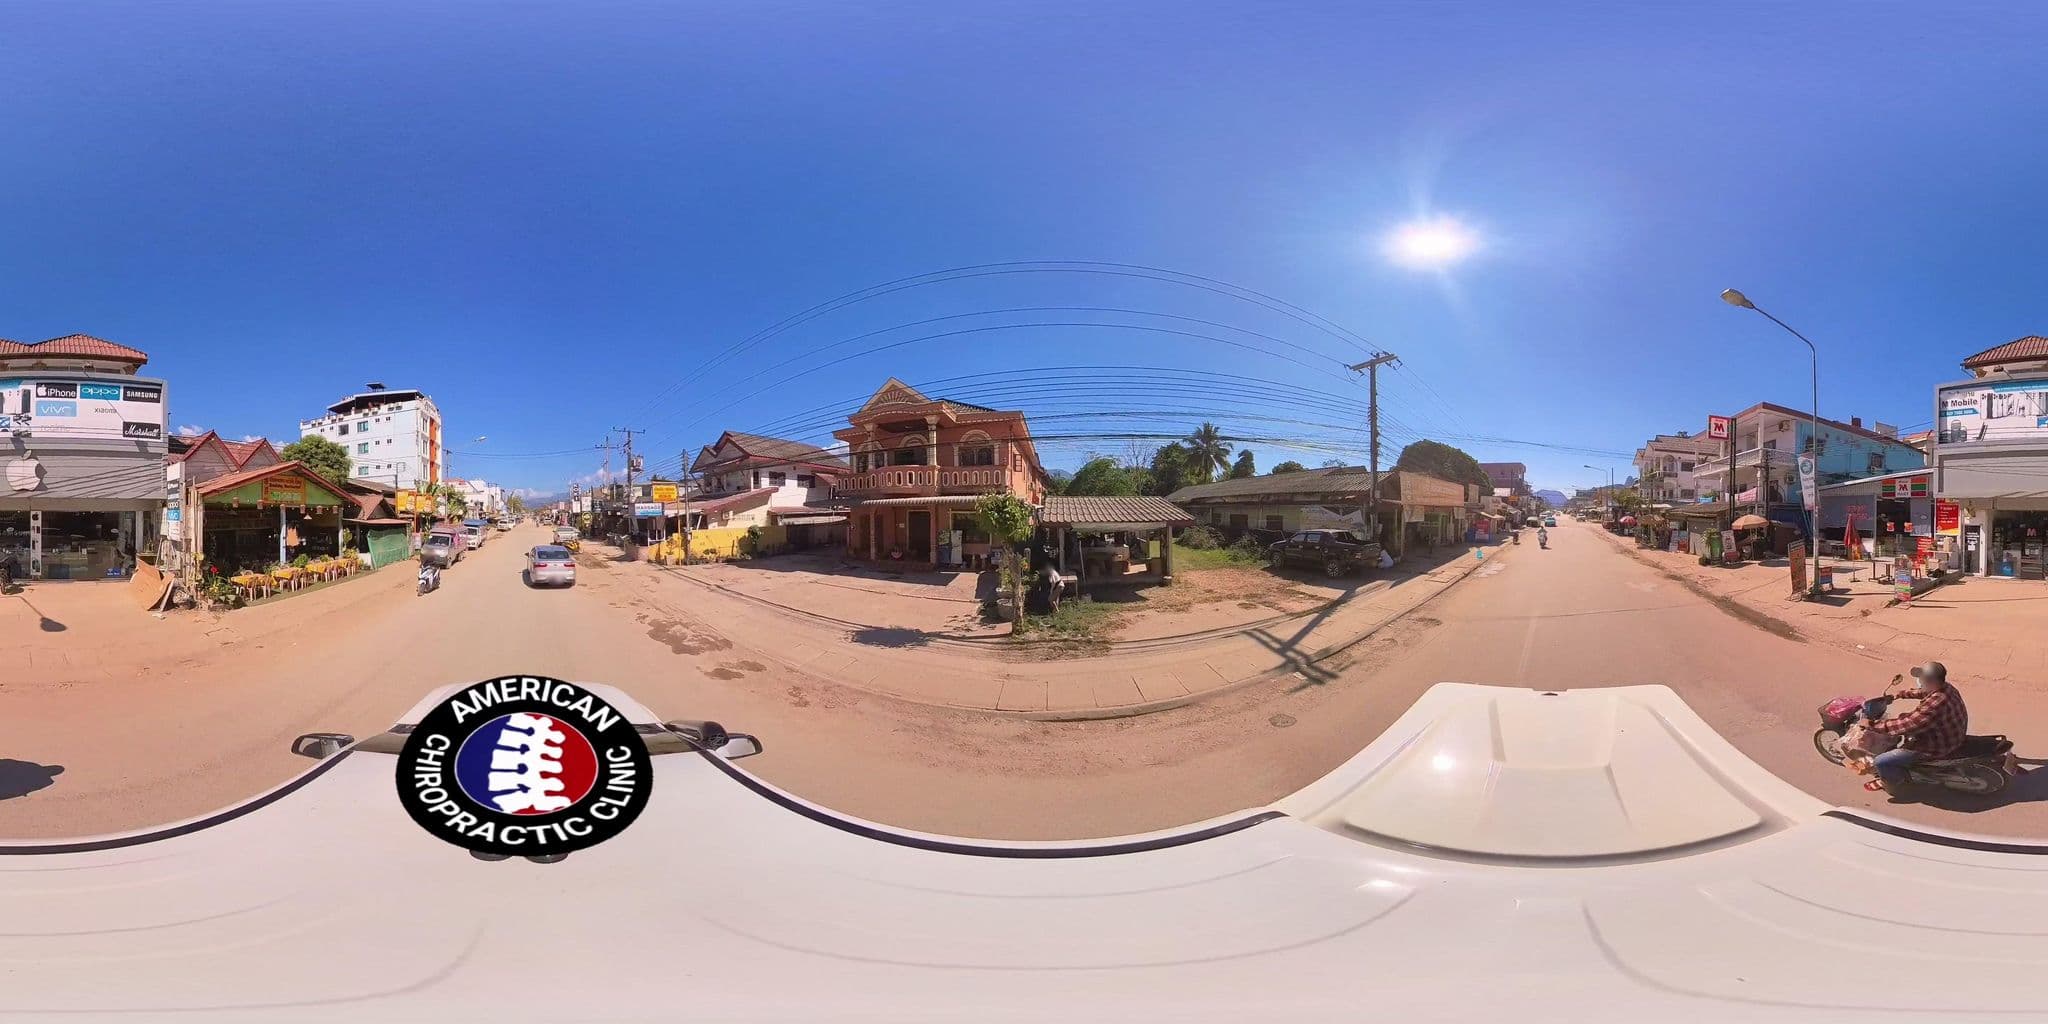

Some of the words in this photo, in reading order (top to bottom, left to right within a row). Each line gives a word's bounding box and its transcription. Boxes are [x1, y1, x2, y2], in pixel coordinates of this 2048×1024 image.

[48, 388, 76, 398] iPhone
[81, 387, 119, 396] oppo
[126, 390, 158, 399] SAMSUNG
[1942, 401, 1949, 409] M
[1951, 399, 1978, 408] Mobile
[124, 425, 159, 437] Marshall
